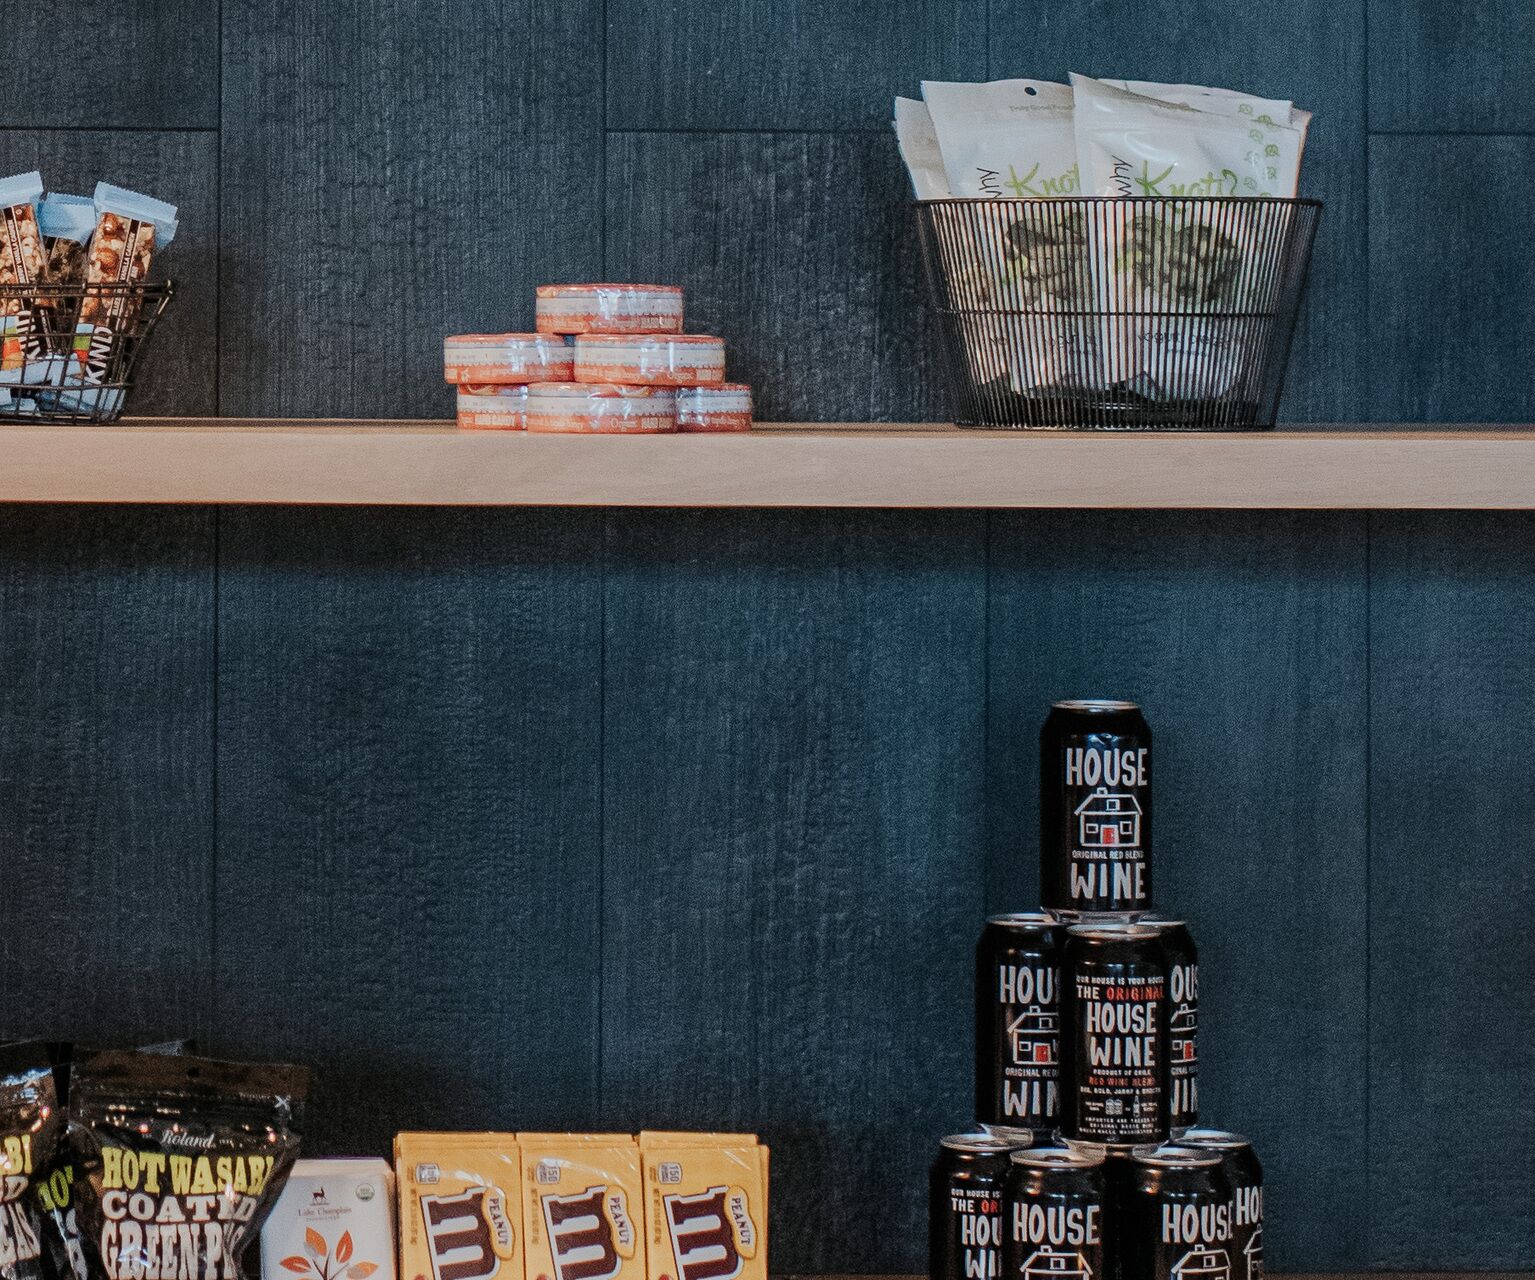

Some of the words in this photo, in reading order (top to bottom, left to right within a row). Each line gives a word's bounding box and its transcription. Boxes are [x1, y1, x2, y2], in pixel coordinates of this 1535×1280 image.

[83, 326, 113, 385] KIND
[1065, 747, 1148, 787] HOUSE
[1071, 850, 1107, 859] ORIGINAL
[1109, 850, 1124, 859] RED
[1070, 862, 1146, 899] WINE
[1076, 985, 1100, 1000] THE
[1106, 986, 1165, 1000] ORIGINAL
[1086, 1001, 1157, 1034] HOUSE
[1090, 1036, 1156, 1067] WINE
[1005, 1067, 1041, 1078] ORIGINAL
[161, 1129, 216, 1149] Roland
[101, 1146, 165, 1192] HOT
[168, 1152, 275, 1195] WASABI
[669, 1165, 680, 1183] 150
[101, 1190, 257, 1223] COATED
[951, 1198, 974, 1213] THE
[966, 1189, 990, 1199] HOUSE
[489, 1198, 509, 1246] PEANUT
[609, 1196, 630, 1245] PEANUT
[730, 1196, 752, 1246] PEANUT
[1013, 1202, 1102, 1245] HOUSE
[1162, 1201, 1234, 1245] HOUSE
